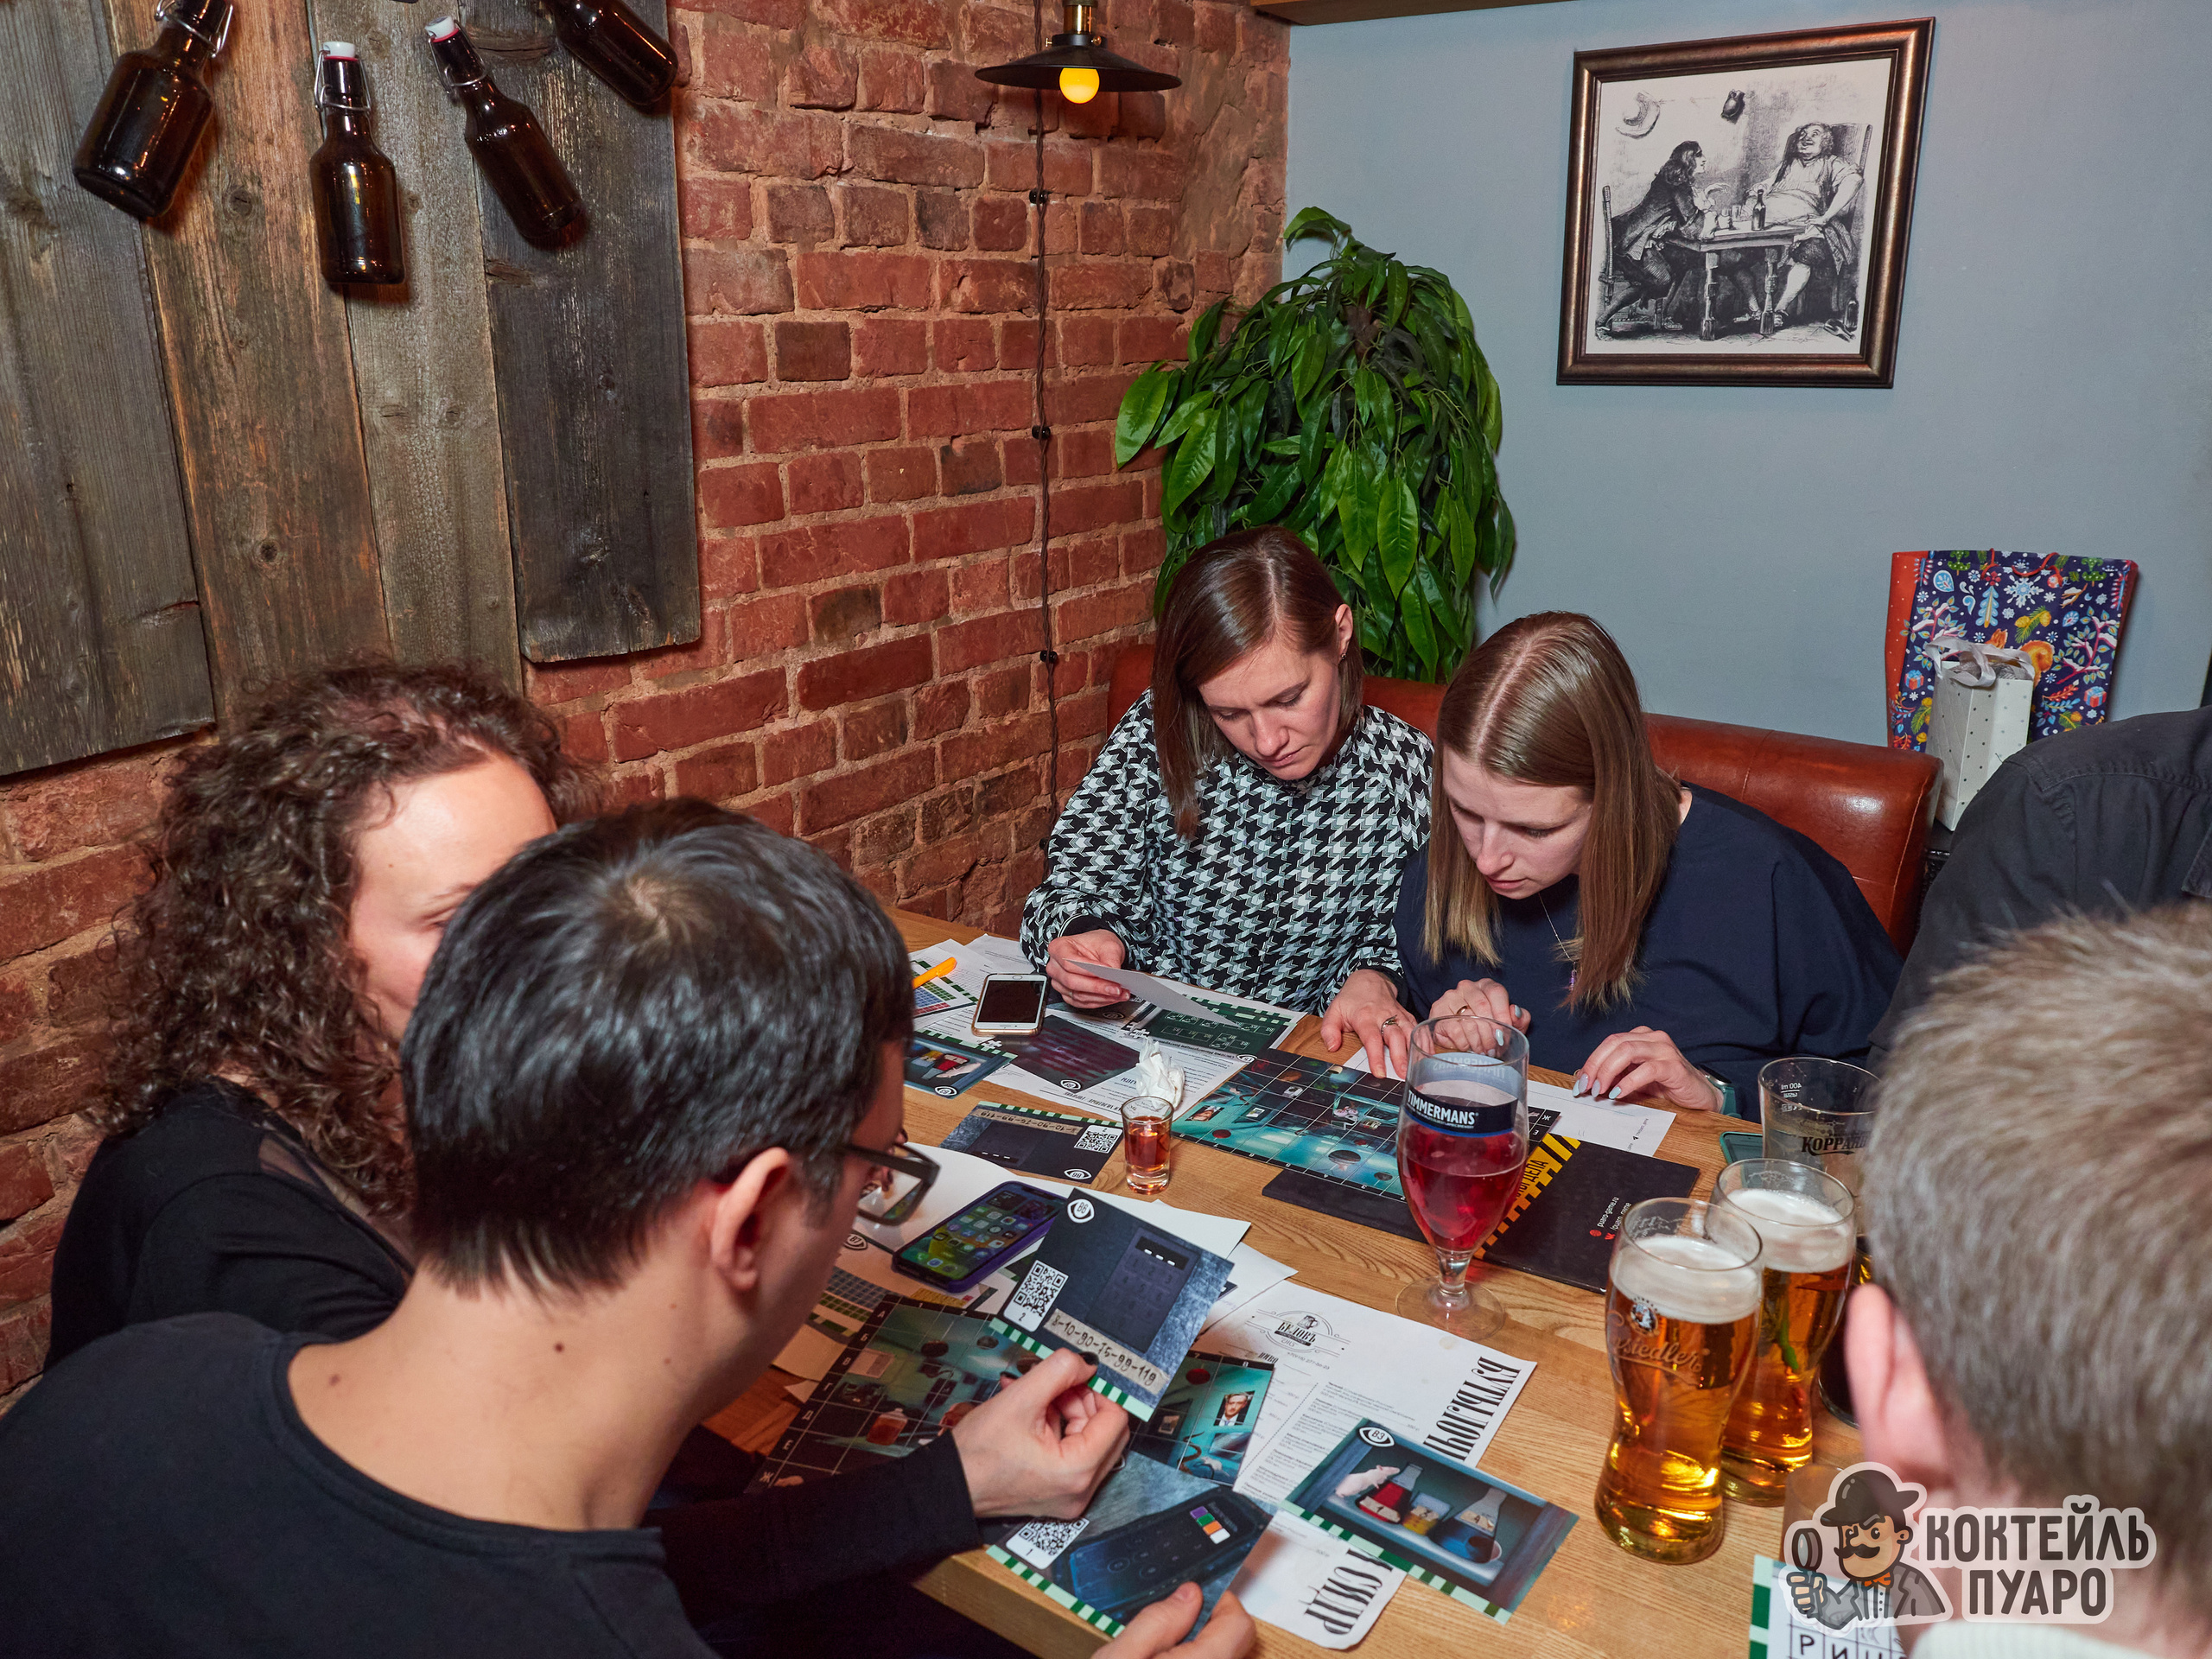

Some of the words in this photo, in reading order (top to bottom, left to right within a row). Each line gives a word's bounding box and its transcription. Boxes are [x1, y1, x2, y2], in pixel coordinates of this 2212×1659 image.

[1408, 1090, 1477, 1125] TIMMERMANS
[1077, 1202, 1088, 1213] B6
[1019, 1313, 1026, 1322] 2
[1277, 1322, 1316, 1343] БЕЛОВЪ
[1258, 1352, 1279, 1363] ПИВО
[1372, 1430, 1384, 1440] B3
[1299, 1567, 1382, 1635] СИДР
